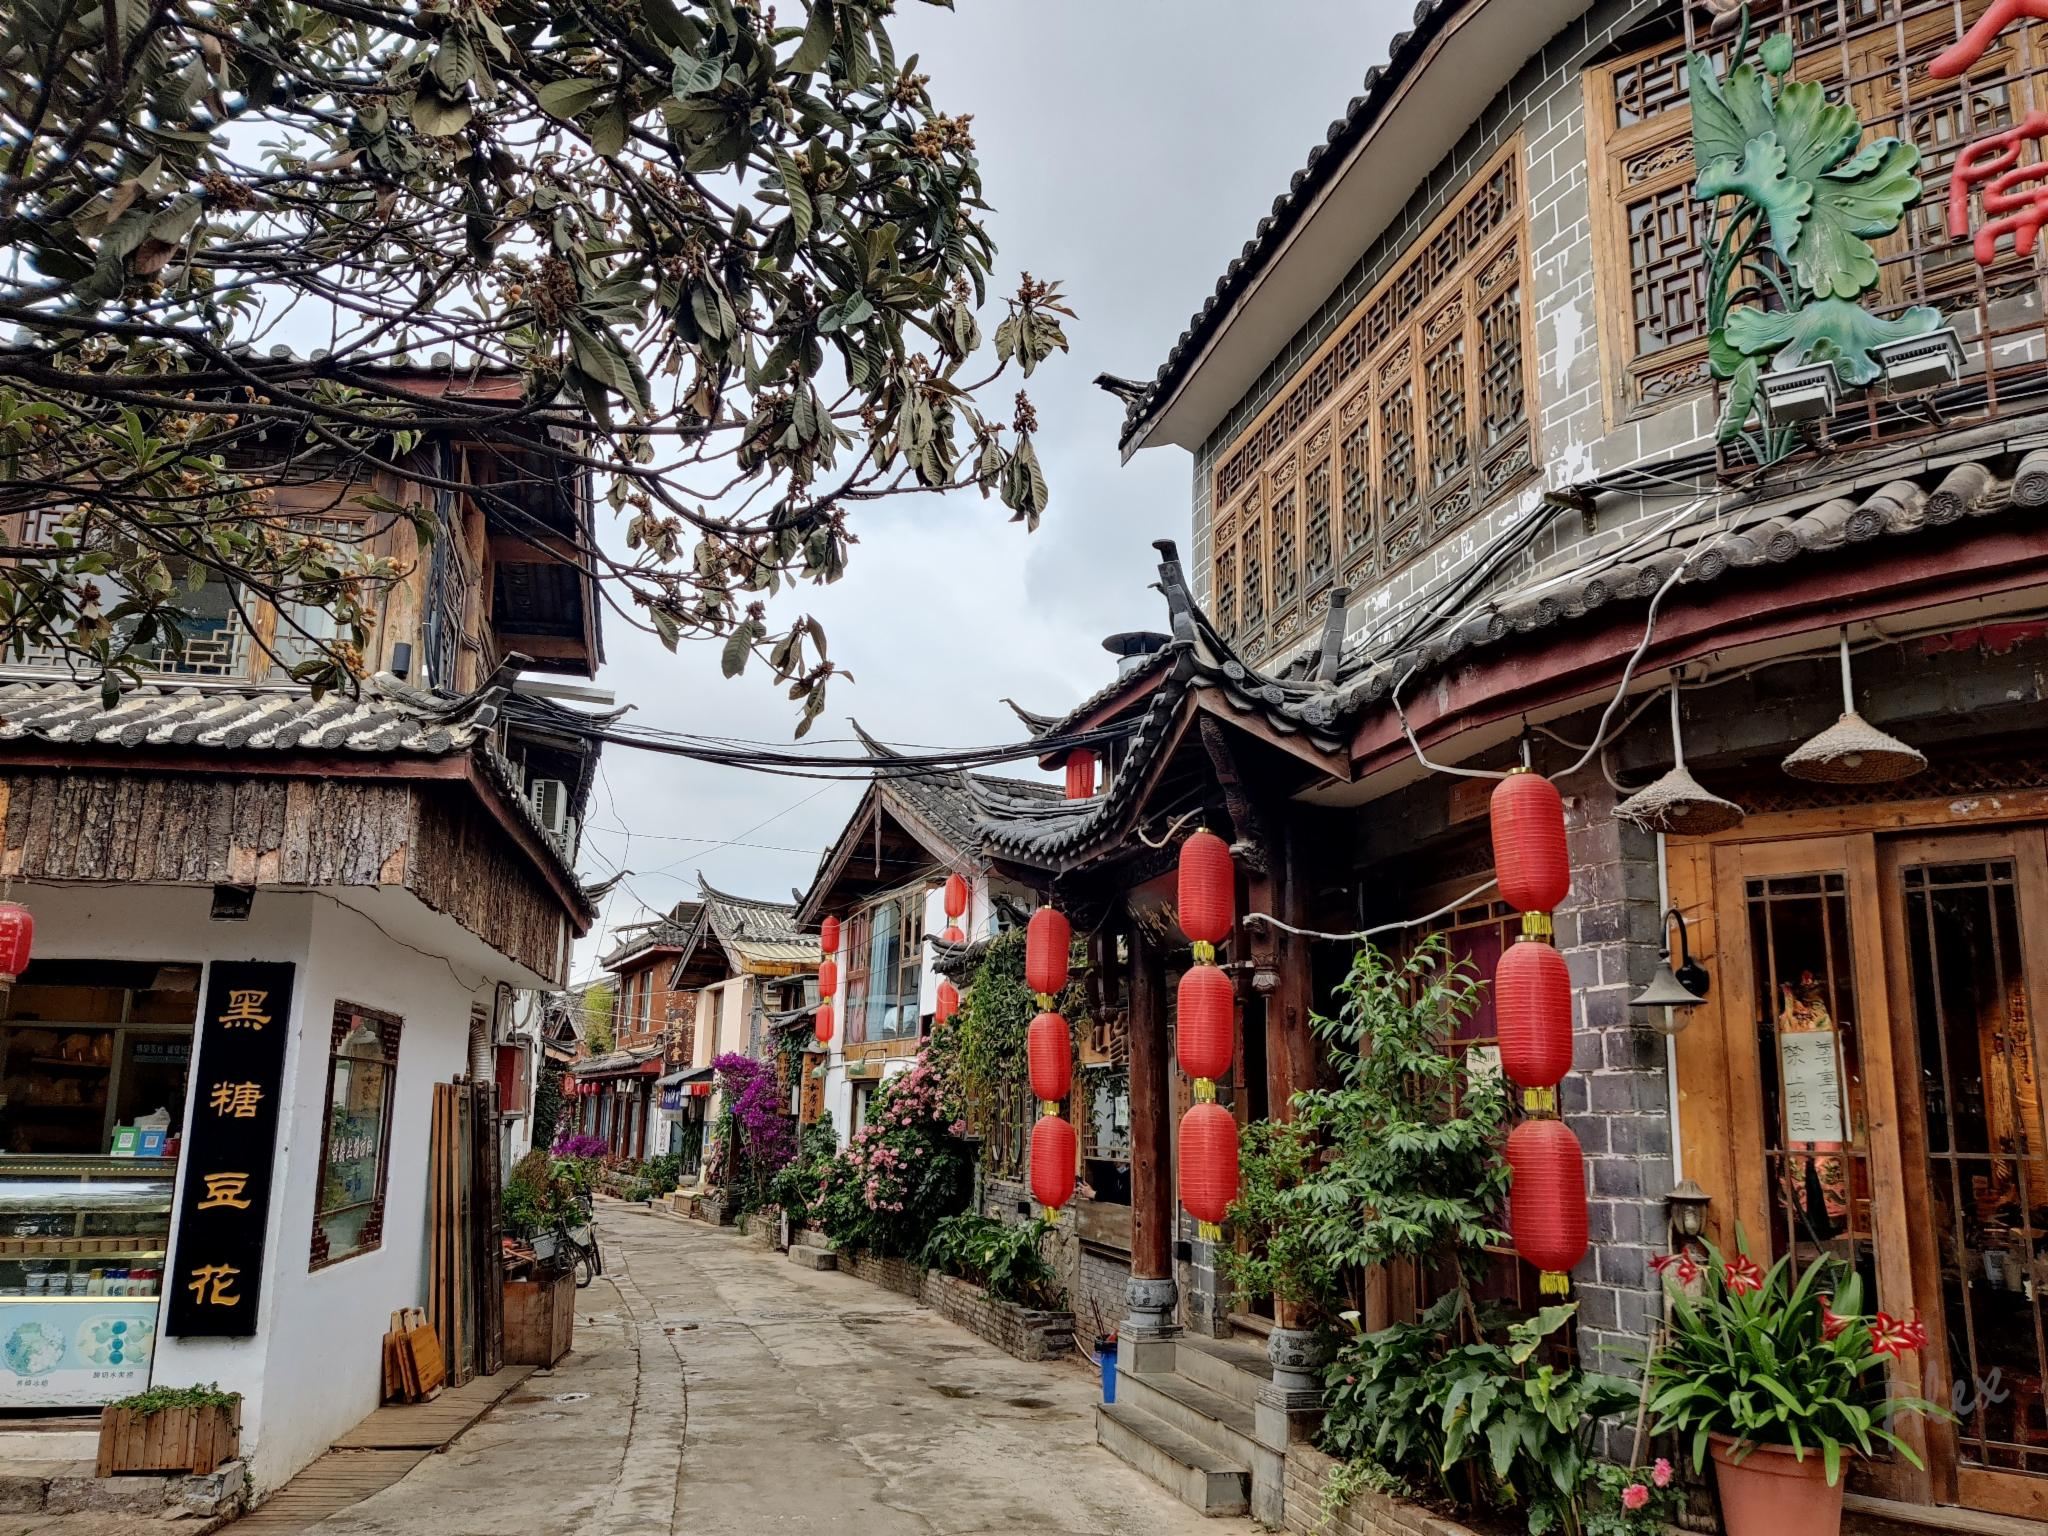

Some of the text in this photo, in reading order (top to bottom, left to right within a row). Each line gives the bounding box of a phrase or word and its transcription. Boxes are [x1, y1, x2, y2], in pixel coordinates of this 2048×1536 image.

[188, 989, 272, 1306] 黑糖豆花
[1784, 1042, 1816, 1132] 禁止拍照
